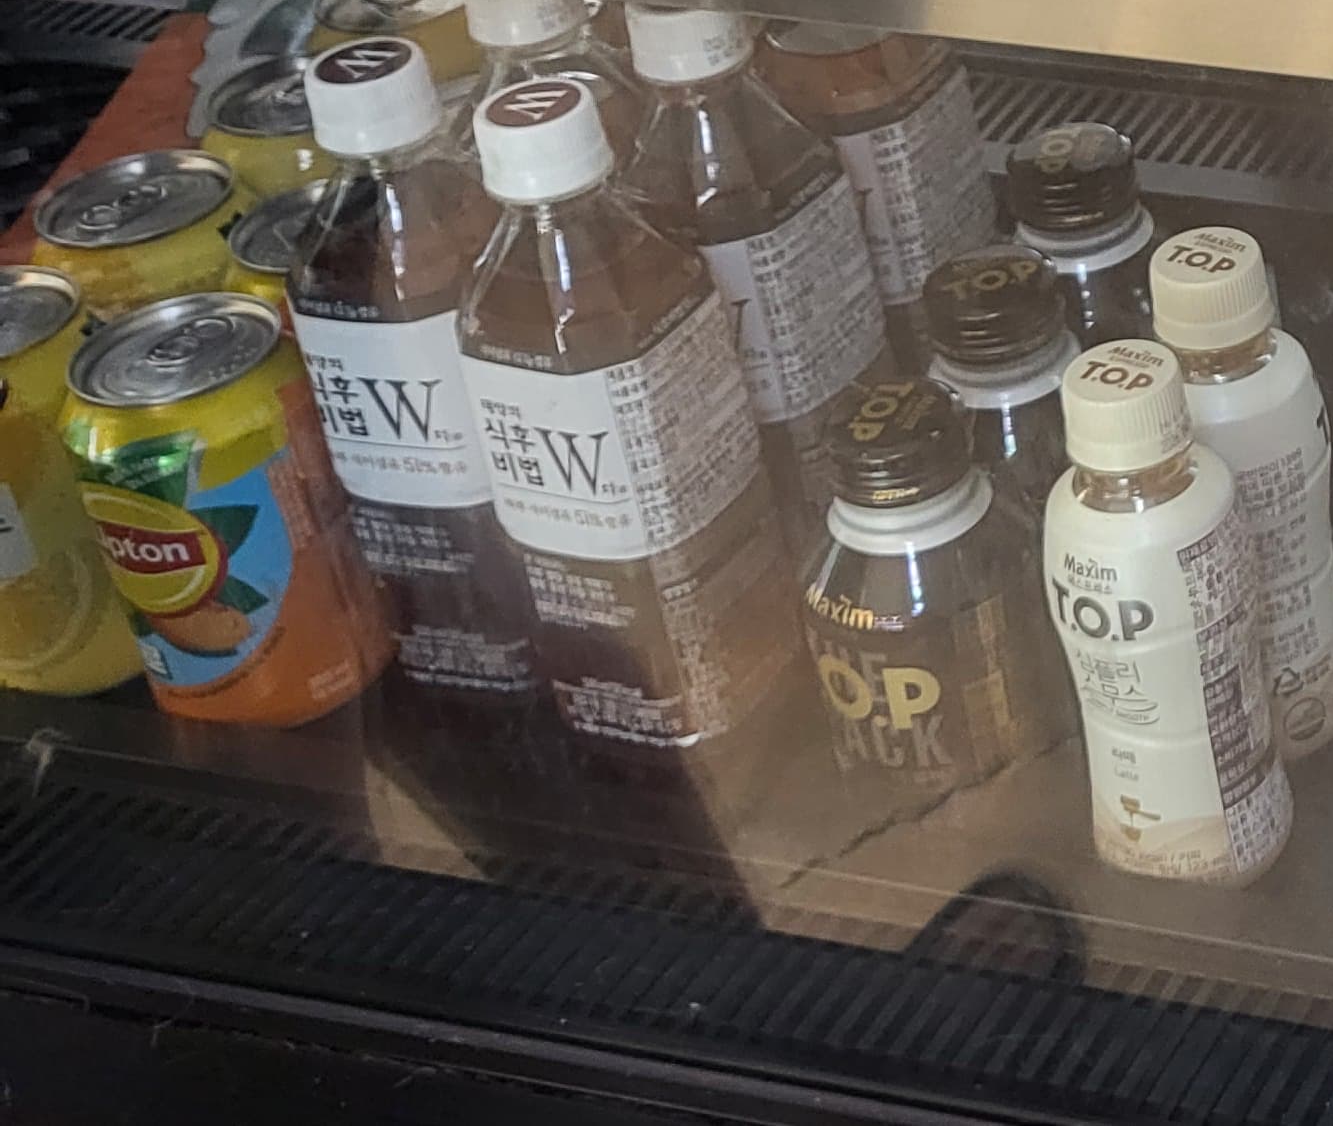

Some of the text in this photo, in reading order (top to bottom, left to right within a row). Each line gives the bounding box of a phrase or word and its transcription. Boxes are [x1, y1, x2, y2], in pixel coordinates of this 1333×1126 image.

[1194, 231, 1247, 253] Maxim
[1166, 244, 1237, 274] T.O.P
[1107, 345, 1165, 368] Maxim
[1079, 360, 1155, 391] T.O.P
[356, 376, 443, 442] W
[485, 418, 537, 453] 식후
[534, 426, 609, 498] W
[491, 451, 545, 487] 비법
[1064, 552, 1118, 582] Maxim
[806, 582, 874, 630] Maxim
[1052, 575, 1155, 641] T.O.P
